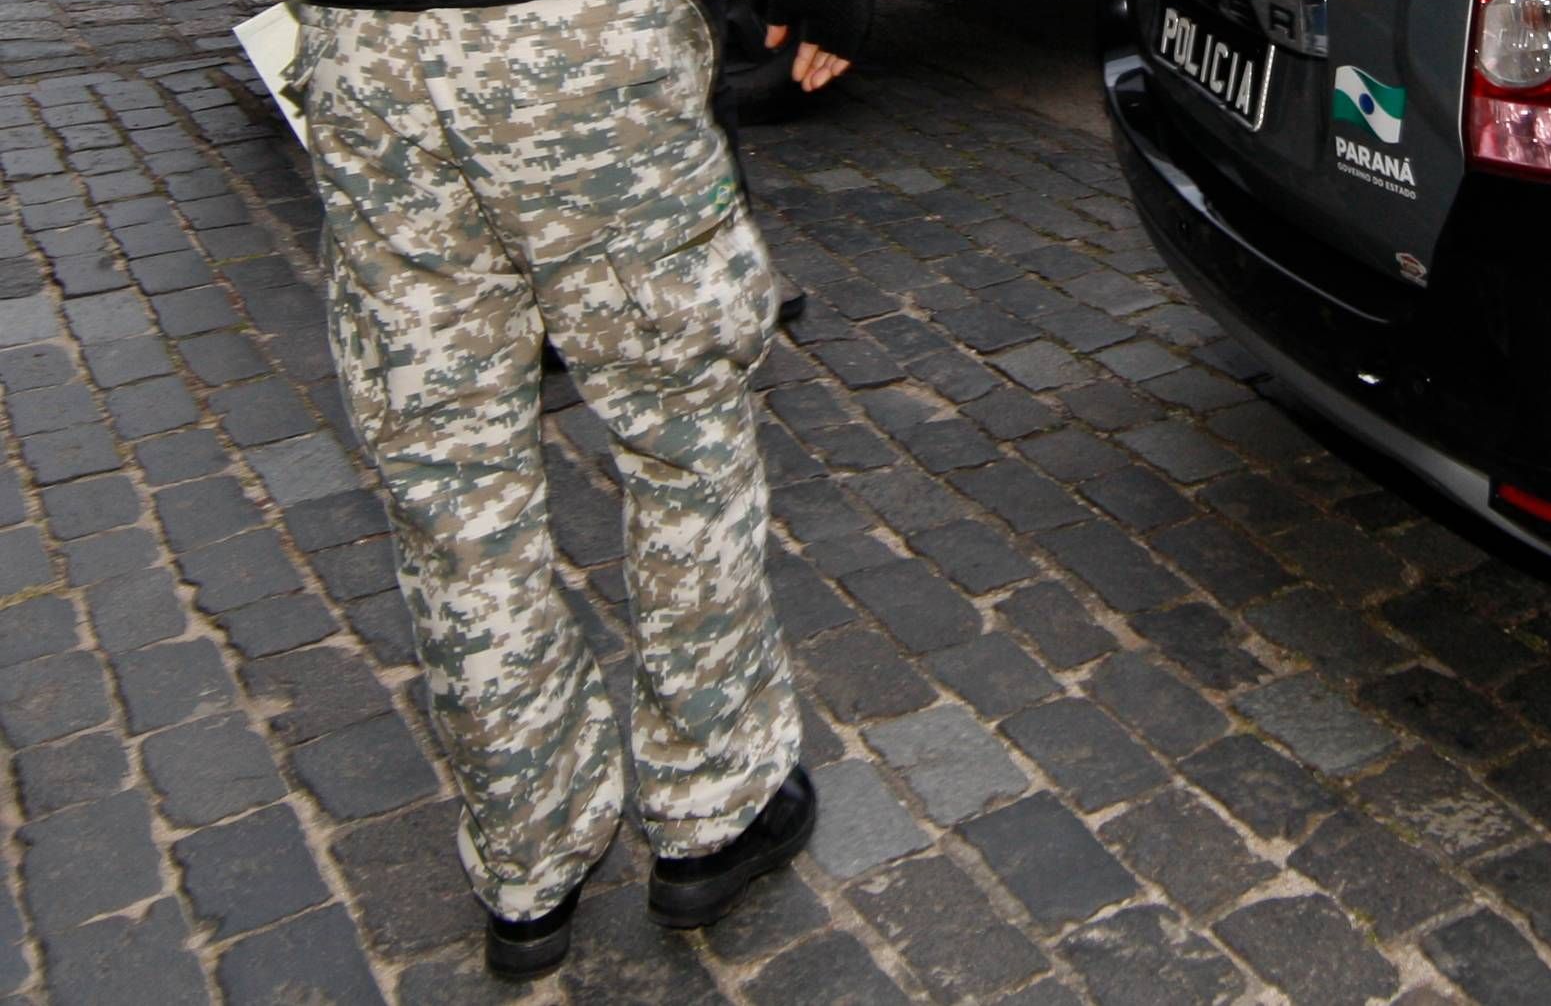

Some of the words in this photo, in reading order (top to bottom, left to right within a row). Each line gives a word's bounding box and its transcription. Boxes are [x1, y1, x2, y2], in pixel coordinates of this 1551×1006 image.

[1160, 7, 1254, 116] POLICIA
[1335, 135, 1416, 186] PARANÁ
[1372, 175, 1384, 188] DO
[1386, 182, 1416, 200] ESTADO
